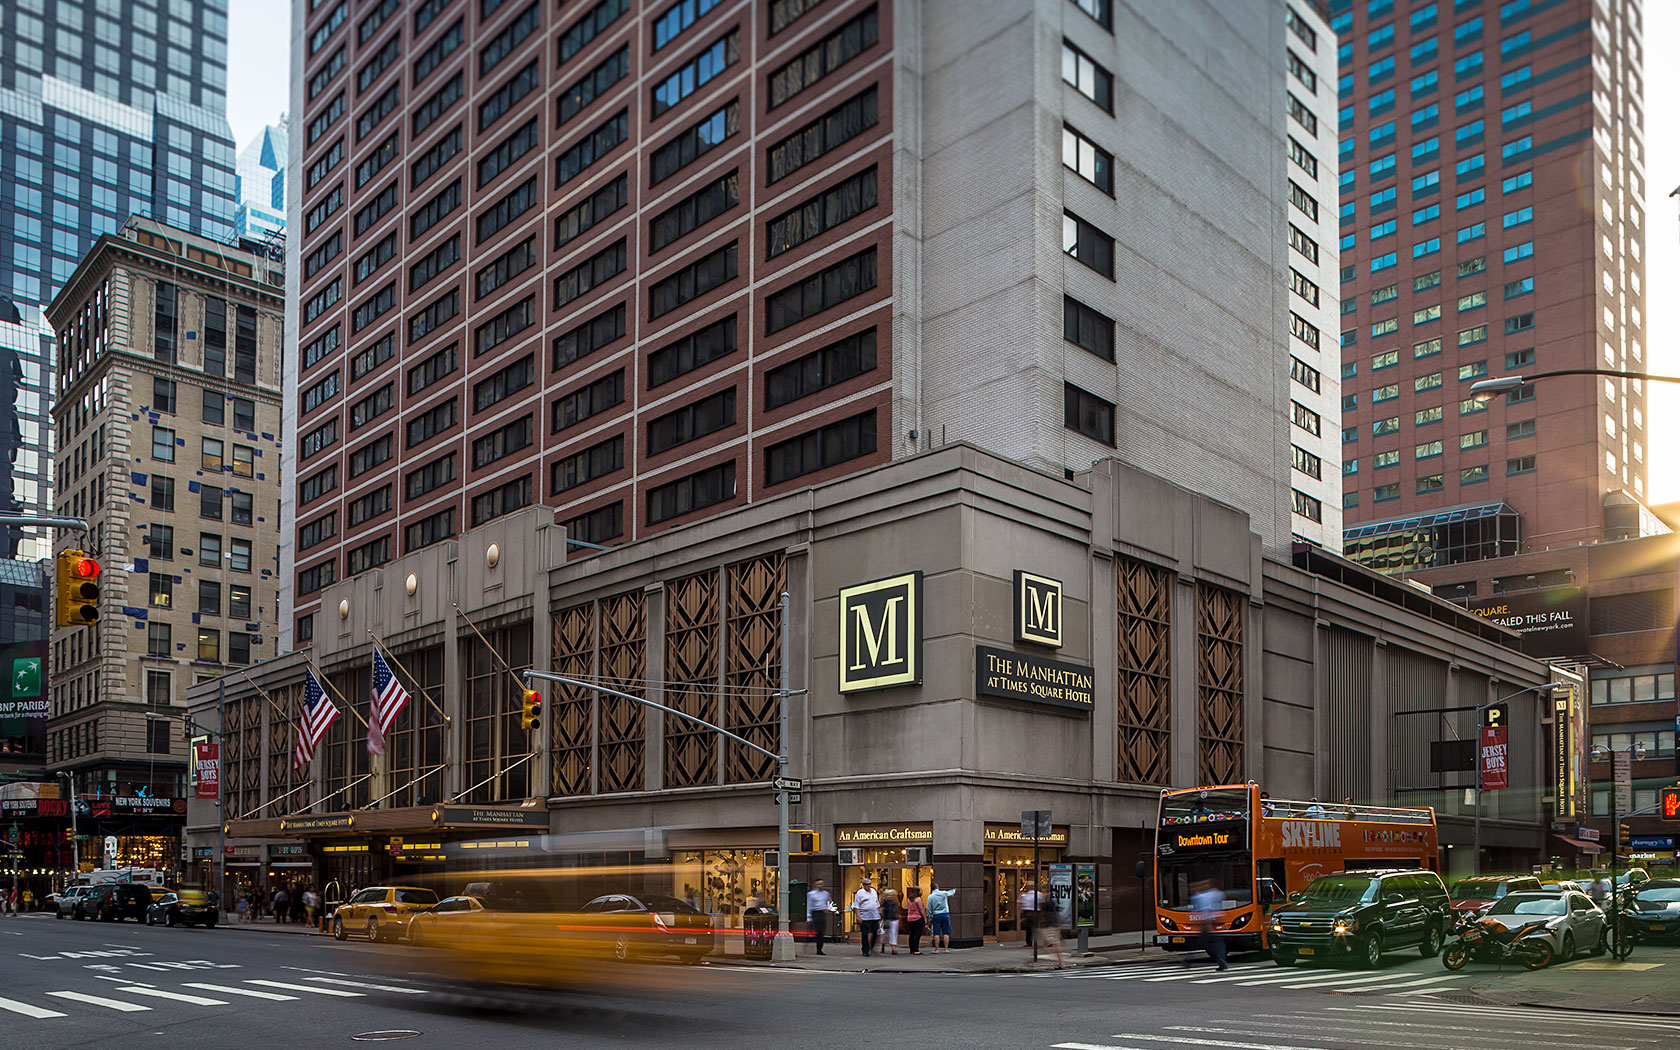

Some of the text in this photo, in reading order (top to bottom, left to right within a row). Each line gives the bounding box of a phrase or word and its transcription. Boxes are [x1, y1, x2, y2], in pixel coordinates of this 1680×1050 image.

[1027, 586, 1057, 633] M
[1491, 610, 1573, 627] EALED THIS FALL.
[850, 596, 904, 670] M
[987, 654, 1092, 689] THE MANHATTAN
[987, 676, 1093, 704] AT TIMES SQUARE HOTEL
[0, 700, 49, 712] BNP PARIBA
[1482, 744, 1507, 758] JERSEY
[197, 759, 219, 770] JERSEY
[1486, 757, 1505, 769] BOYS
[200, 770, 217, 780] BOYS
[38, 800, 68, 815] ROCKY
[115, 797, 170, 807] NEW YORK SOUVENIRS
[840, 827, 933, 841] An American Craftsman
[985, 828, 996, 840] An
[997, 829, 1031, 841] Americ
[1178, 832, 1229, 847] Downtown Tour
[1281, 820, 1342, 848] SKYLINE
